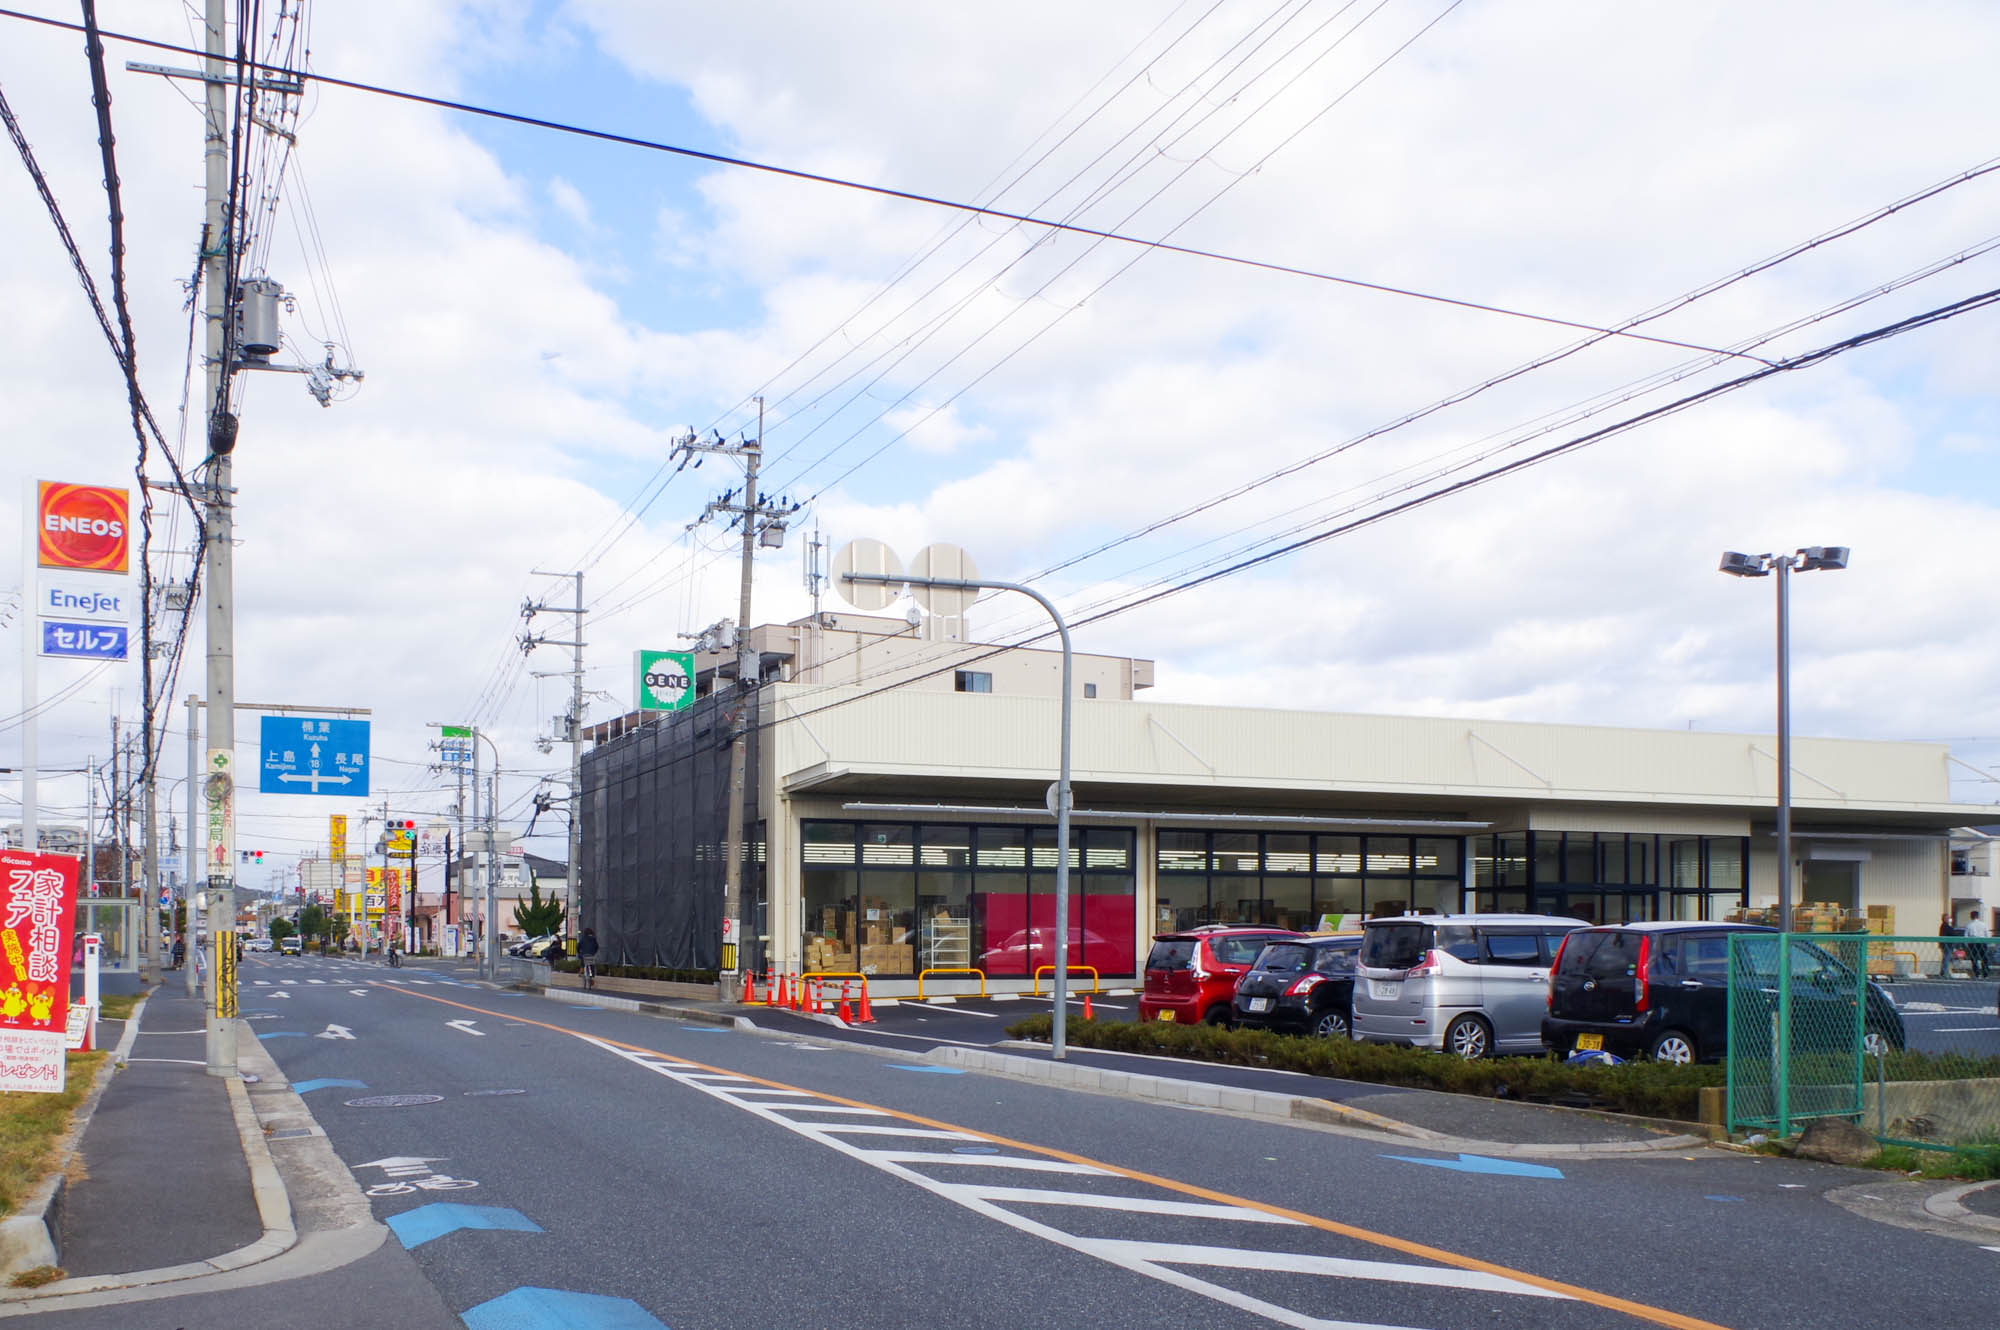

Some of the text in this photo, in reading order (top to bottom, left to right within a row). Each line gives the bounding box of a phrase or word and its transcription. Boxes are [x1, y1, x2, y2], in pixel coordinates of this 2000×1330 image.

[45, 514, 122, 538] ENEOS
[50, 589, 120, 613] Enejet
[54, 627, 119, 651] セルフ
[645, 675, 689, 688] GENE
[266, 750, 296, 762] 上島
[335, 752, 364, 766] 長尾
[5, 870, 33, 928] フェア
[30, 869, 64, 982] 家計相談
[0, 1061, 57, 1081] レゼント!
